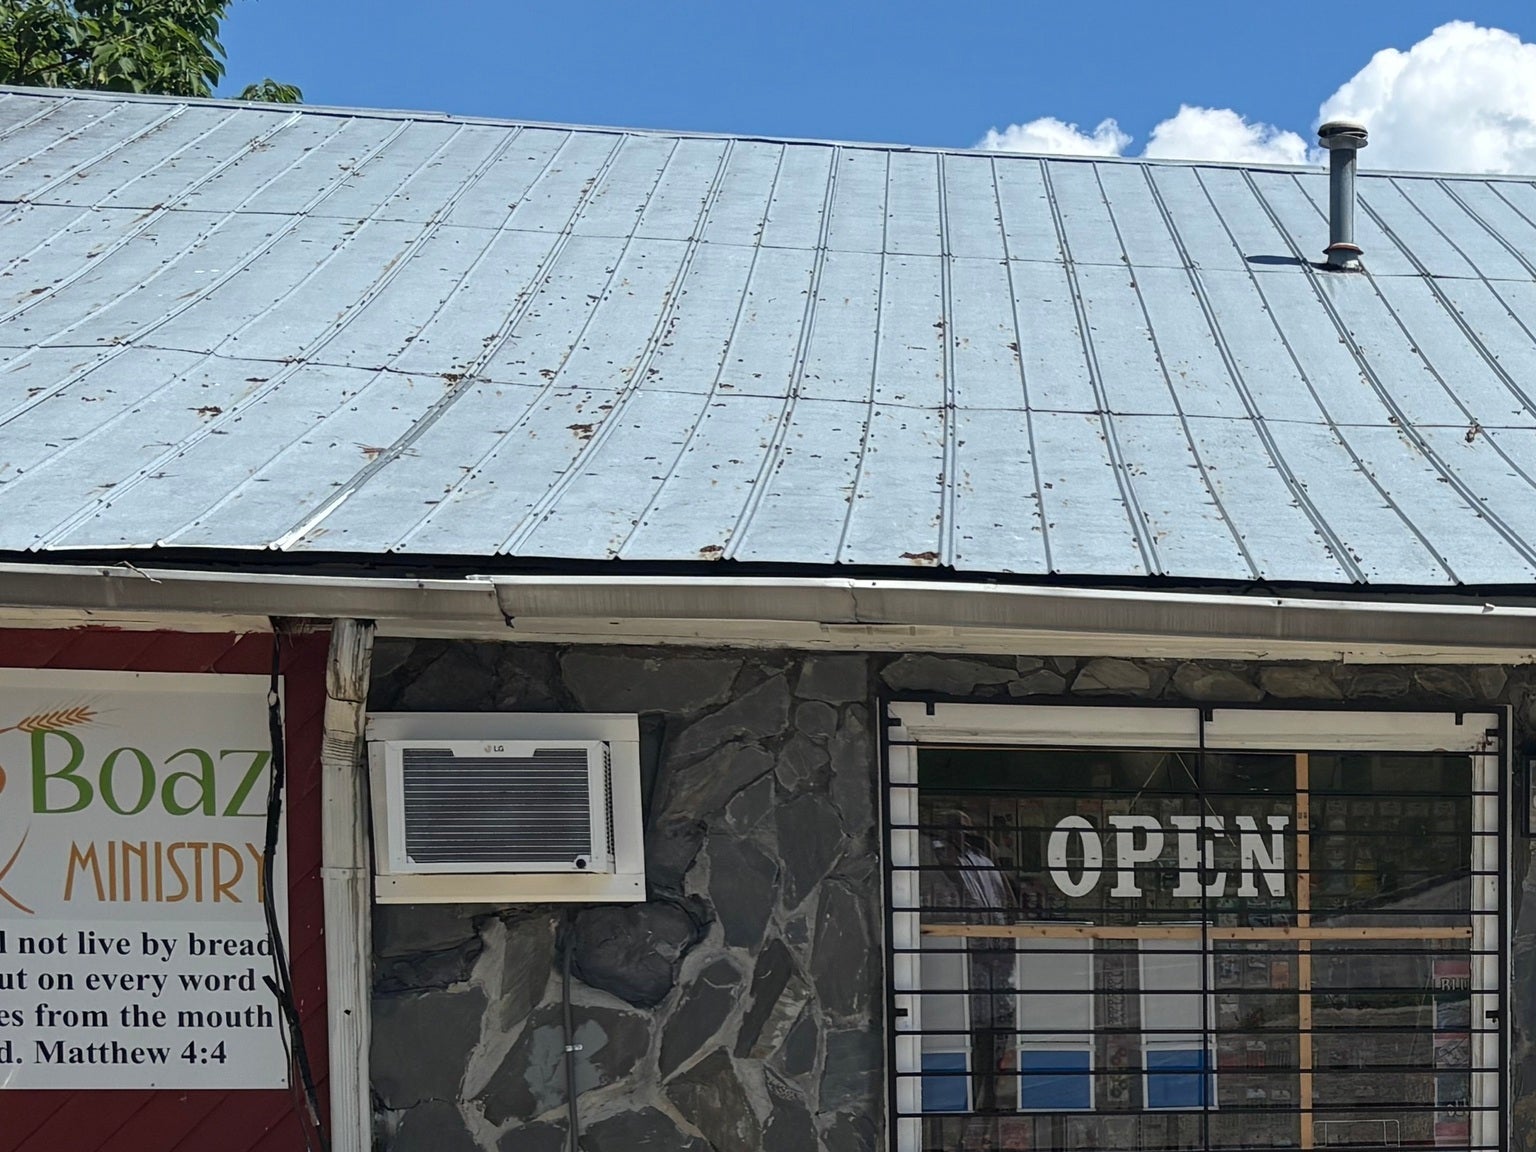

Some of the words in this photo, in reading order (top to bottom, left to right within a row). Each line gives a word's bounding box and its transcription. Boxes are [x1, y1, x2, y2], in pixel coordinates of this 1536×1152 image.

[31, 728, 273, 817] Boaz
[64, 840, 266, 903] MINISTRY
[1047, 815, 1290, 897] OPEN
[18, 932, 68, 954] not
[78, 930, 131, 955] live
[142, 931, 178, 962] by
[188, 932, 274, 956] bread
[38, 973, 74, 990] on
[85, 973, 168, 998] every
[178, 968, 256, 991] word
[34, 1003, 108, 1027] from
[120, 1004, 167, 1027] the
[178, 1005, 274, 1027] mouth
[34, 1040, 171, 1064] Matthew
[181, 1040, 227, 1064] 4:4
